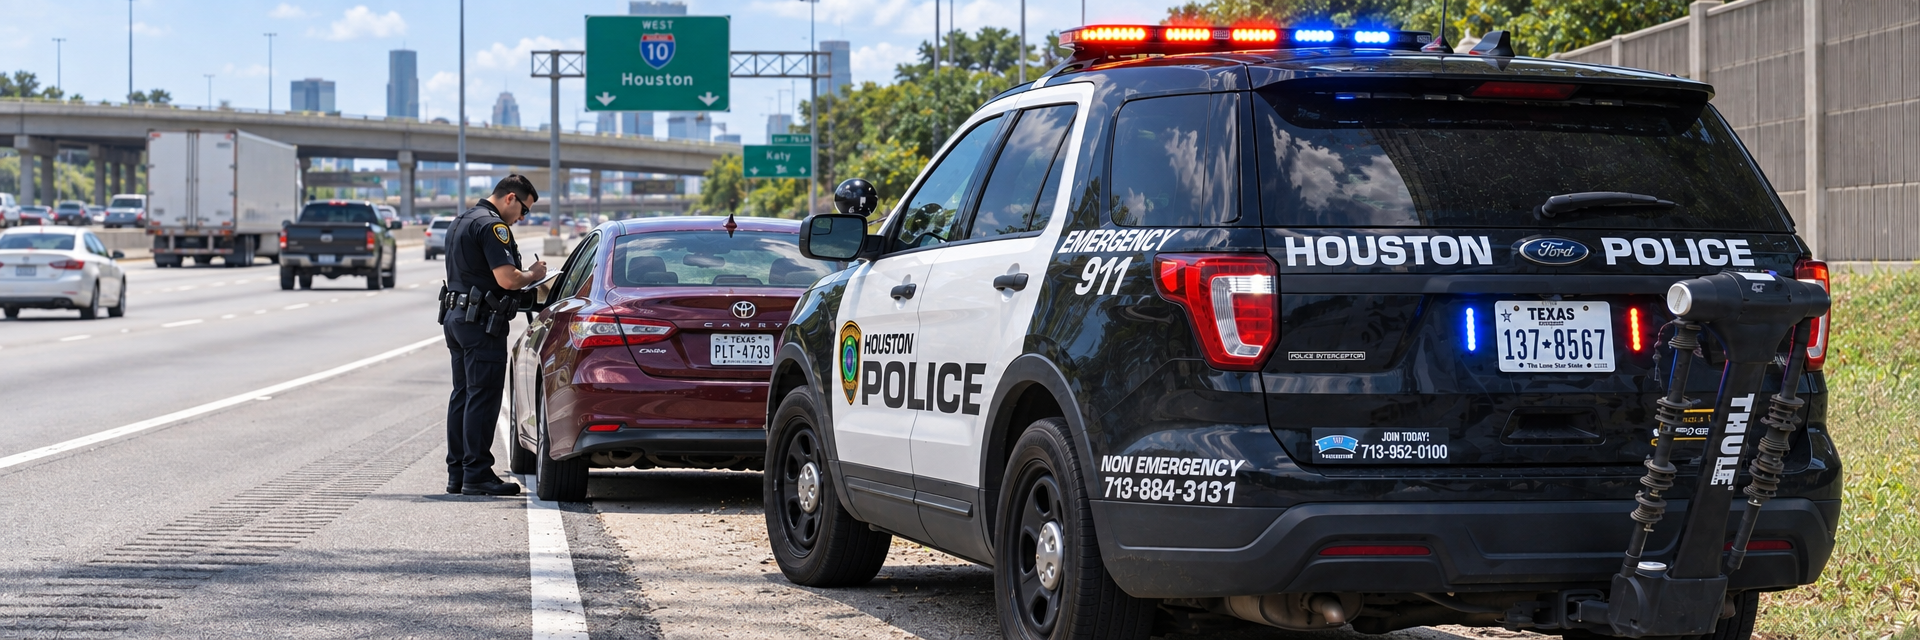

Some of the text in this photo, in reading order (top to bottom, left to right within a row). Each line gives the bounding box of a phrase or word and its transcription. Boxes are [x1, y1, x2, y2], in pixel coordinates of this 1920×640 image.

[642, 20, 673, 30] WEST
[647, 43, 669, 60] 10
[621, 72, 693, 86] Houston
[766, 150, 791, 162] Katy
[1057, 229, 1181, 253] EMERGENCY
[1285, 235, 1493, 266] HOUSTON
[1538, 241, 1575, 257] Ford
[1600, 237, 1755, 266] POLICE
[1075, 256, 1133, 295] 911
[1527, 307, 1575, 320] TEXAS
[864, 333, 914, 355] HOUSTON
[862, 360, 987, 416] POLICE
[1381, 432, 1430, 442] JOIN TODAY!
[1710, 393, 1755, 486] THULE
[1361, 444, 1448, 459] 713-952-0100
[1101, 455, 1245, 477] NON EMERGENCY
[1104, 476, 1236, 504] 713-884-3131
